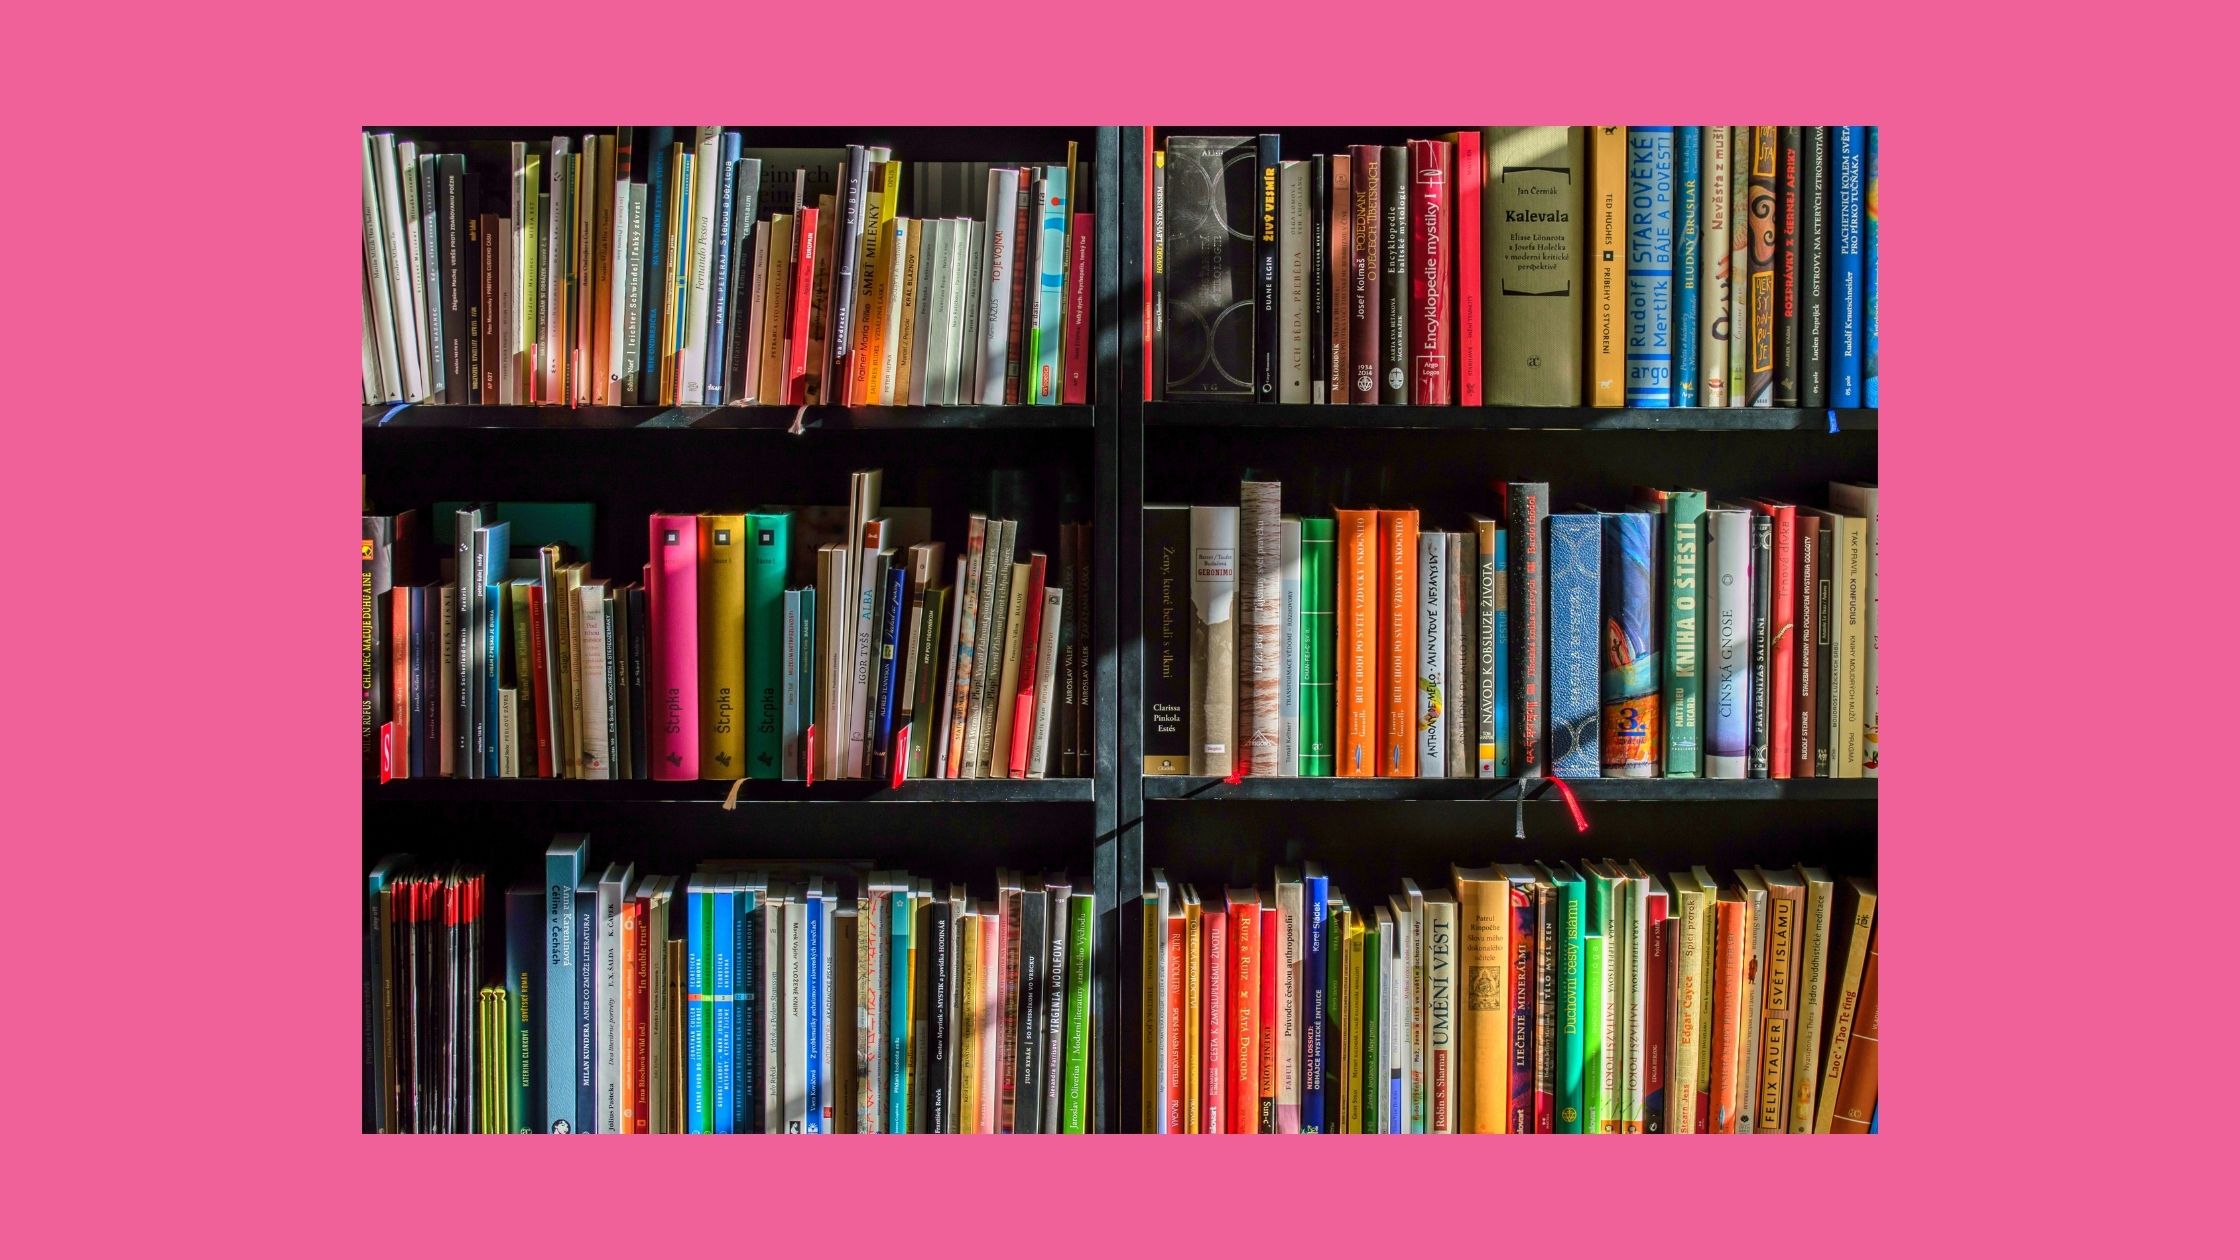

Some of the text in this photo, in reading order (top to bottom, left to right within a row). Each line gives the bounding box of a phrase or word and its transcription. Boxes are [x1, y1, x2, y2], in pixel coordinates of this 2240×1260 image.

[722, 183, 731, 199] bez
[724, 161, 732, 181] teba
[1262, 168, 1275, 211] VESMÍR
[1786, 148, 1796, 188] AFRIKY
[847, 178, 858, 224] KUBUS
[1505, 210, 1569, 222] Kalevala
[1630, 137, 1653, 263] STAROVĚKÉ
[1654, 137, 1670, 262] BÁJE A POVĚSTI
[1783, 193, 1795, 234] ČIERNEJ
[1840, 157, 1850, 254] PLACHETNICÍ KOLEM
[1849, 155, 1859, 254] PRO PÍRKO TUČŇÁKA
[720, 210, 729, 236] tebou
[1261, 215, 1274, 242] ŽIVÝ
[1426, 203, 1440, 254] mystiky
[1683, 179, 1696, 288] BLUDNÝ BRUSLAŘ
[695, 216, 708, 290] Fernando Pessoa
[717, 254, 726, 292] PETERAJ
[992, 230, 1003, 282] TO JE VOJNA!
[1355, 191, 1366, 319] Josef Kolmaš POJEDNÁNÍ
[858, 204, 879, 381] Rainer Maria Rilke SMRŤ MILENKY
[1424, 259, 1440, 349] Encyklopedie
[1784, 252, 1794, 317] ROZPRÁVKY
[716, 295, 724, 324] KAMIL
[1292, 252, 1303, 370] ACH BĚDA, PŘEBĚDA
[1630, 281, 1646, 347] Rudolf
[1654, 281, 1668, 347] Mertlík
[1602, 313, 1611, 354] STVORENÍ
[1631, 367, 1668, 383] argo
[362, 572, 371, 586] INÉ
[1162, 545, 1174, 574] Ženy,
[362, 596, 371, 619] DÚHU
[1163, 578, 1173, 606] ktoré
[1674, 523, 1696, 677] KNIHA O ŠTĚSTÍ
[362, 620, 372, 651] MAĽUJE
[858, 590, 873, 684] IGOR TYŠŠ ALBA
[1163, 608, 1173, 639] behali
[1480, 563, 1493, 723] NÁVOD K OBSLUZE ŽIVOTA
[363, 654, 372, 688] CHLAPEC
[1163, 650, 1173, 678] vlkmi
[1717, 610, 1733, 717] ČÍNSKÁ GNOSE
[362, 701, 372, 726] RÚFUS
[712, 688, 733, 733] Štrpka
[756, 688, 776, 733] Štrpka
[1675, 688, 1684, 727] MATTHIEU
[1686, 697, 1695, 727] RICARD
[551, 885, 560, 915] Céline
[551, 926, 560, 965] Čechách
[562, 886, 572, 966] Anna Kareninová
[582, 914, 590, 961] LITERATURA?
[1312, 902, 1320, 952] Karel Sládek
[582, 962, 590, 988] ZMŮŽE
[1284, 916, 1294, 1036] Průvodce českou anthroposofií
[1544, 946, 1552, 970] MYSL
[1565, 900, 1578, 1034] Duchovní cesty islámu
[1682, 900, 1696, 1044] Edgar Cayce prorok
[1770, 904, 1788, 1005] SVĚT ISLÁMU
[583, 990, 590, 999] CO
[1050, 940, 1062, 1034] VIRGINIA WOOLFOVÁ
[1514, 944, 1526, 1066] LIEČENIE MINERÁLMI
[1543, 976, 1552, 999] TĚLO
[1070, 913, 1088, 1129] Jaroslav Oliverius Moderní literatury arabského Východu
[1430, 919, 1449, 1127] Robin S. Sharma UMĚNÍ VÉST
[1765, 1025, 1780, 1122] FELIX TAUER
